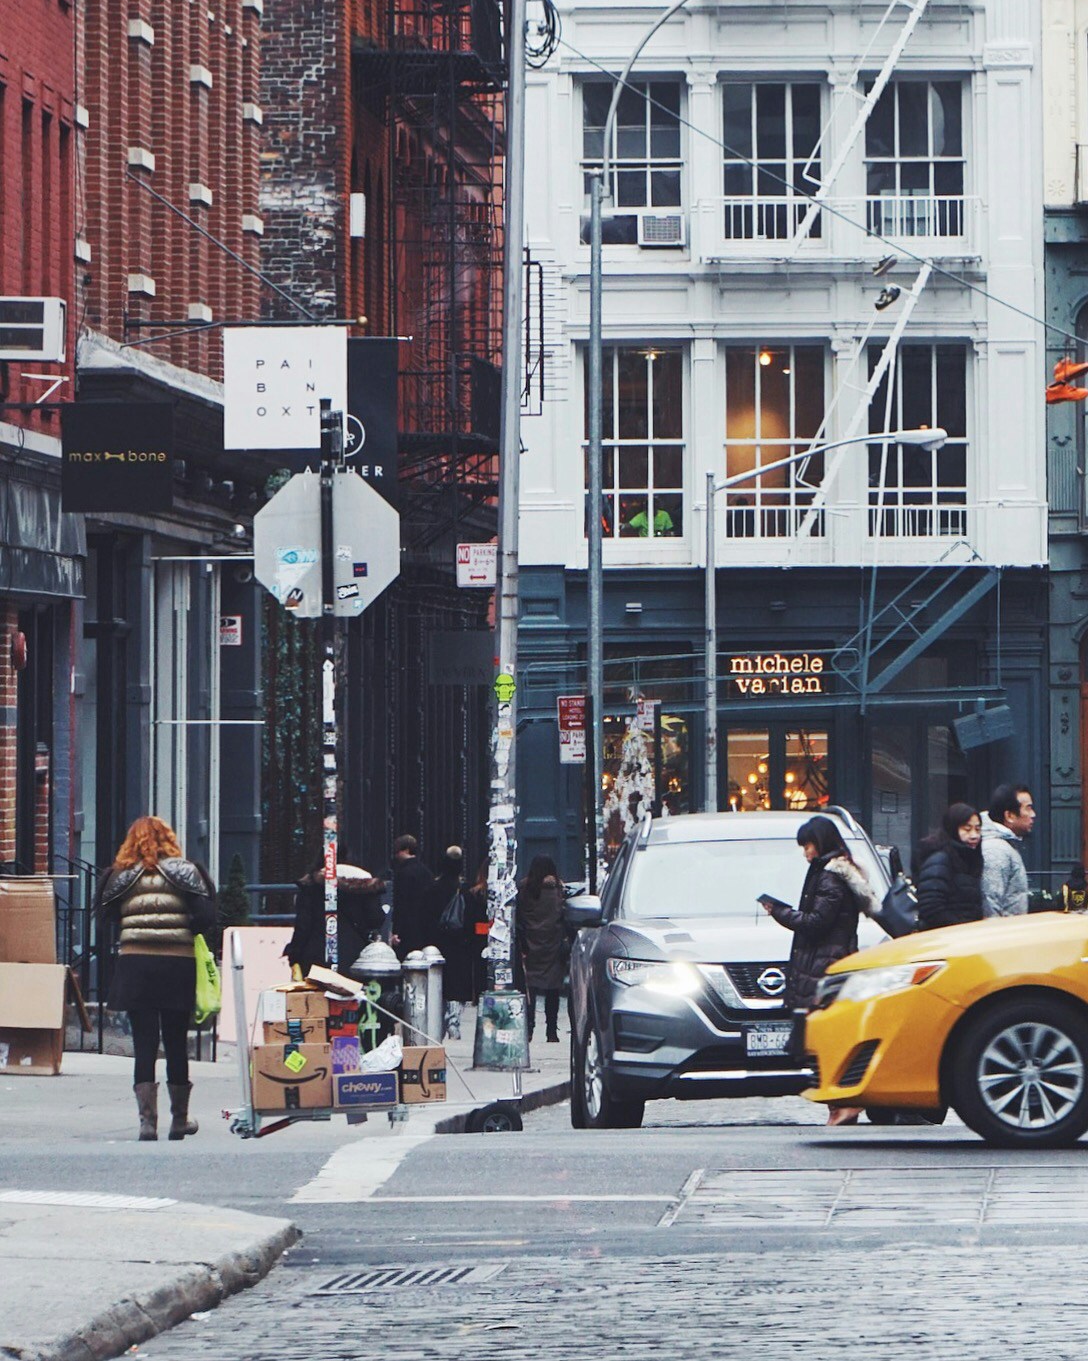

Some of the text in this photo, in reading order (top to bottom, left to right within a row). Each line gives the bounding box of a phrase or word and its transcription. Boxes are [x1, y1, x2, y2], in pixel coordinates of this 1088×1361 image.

[256, 359, 312, 369] PAI
[256, 406, 315, 417] OXT
[69, 450, 167, 463] max bone
[458, 546, 470, 563] NO
[730, 653, 824, 674] michele
[735, 675, 822, 694] varian
